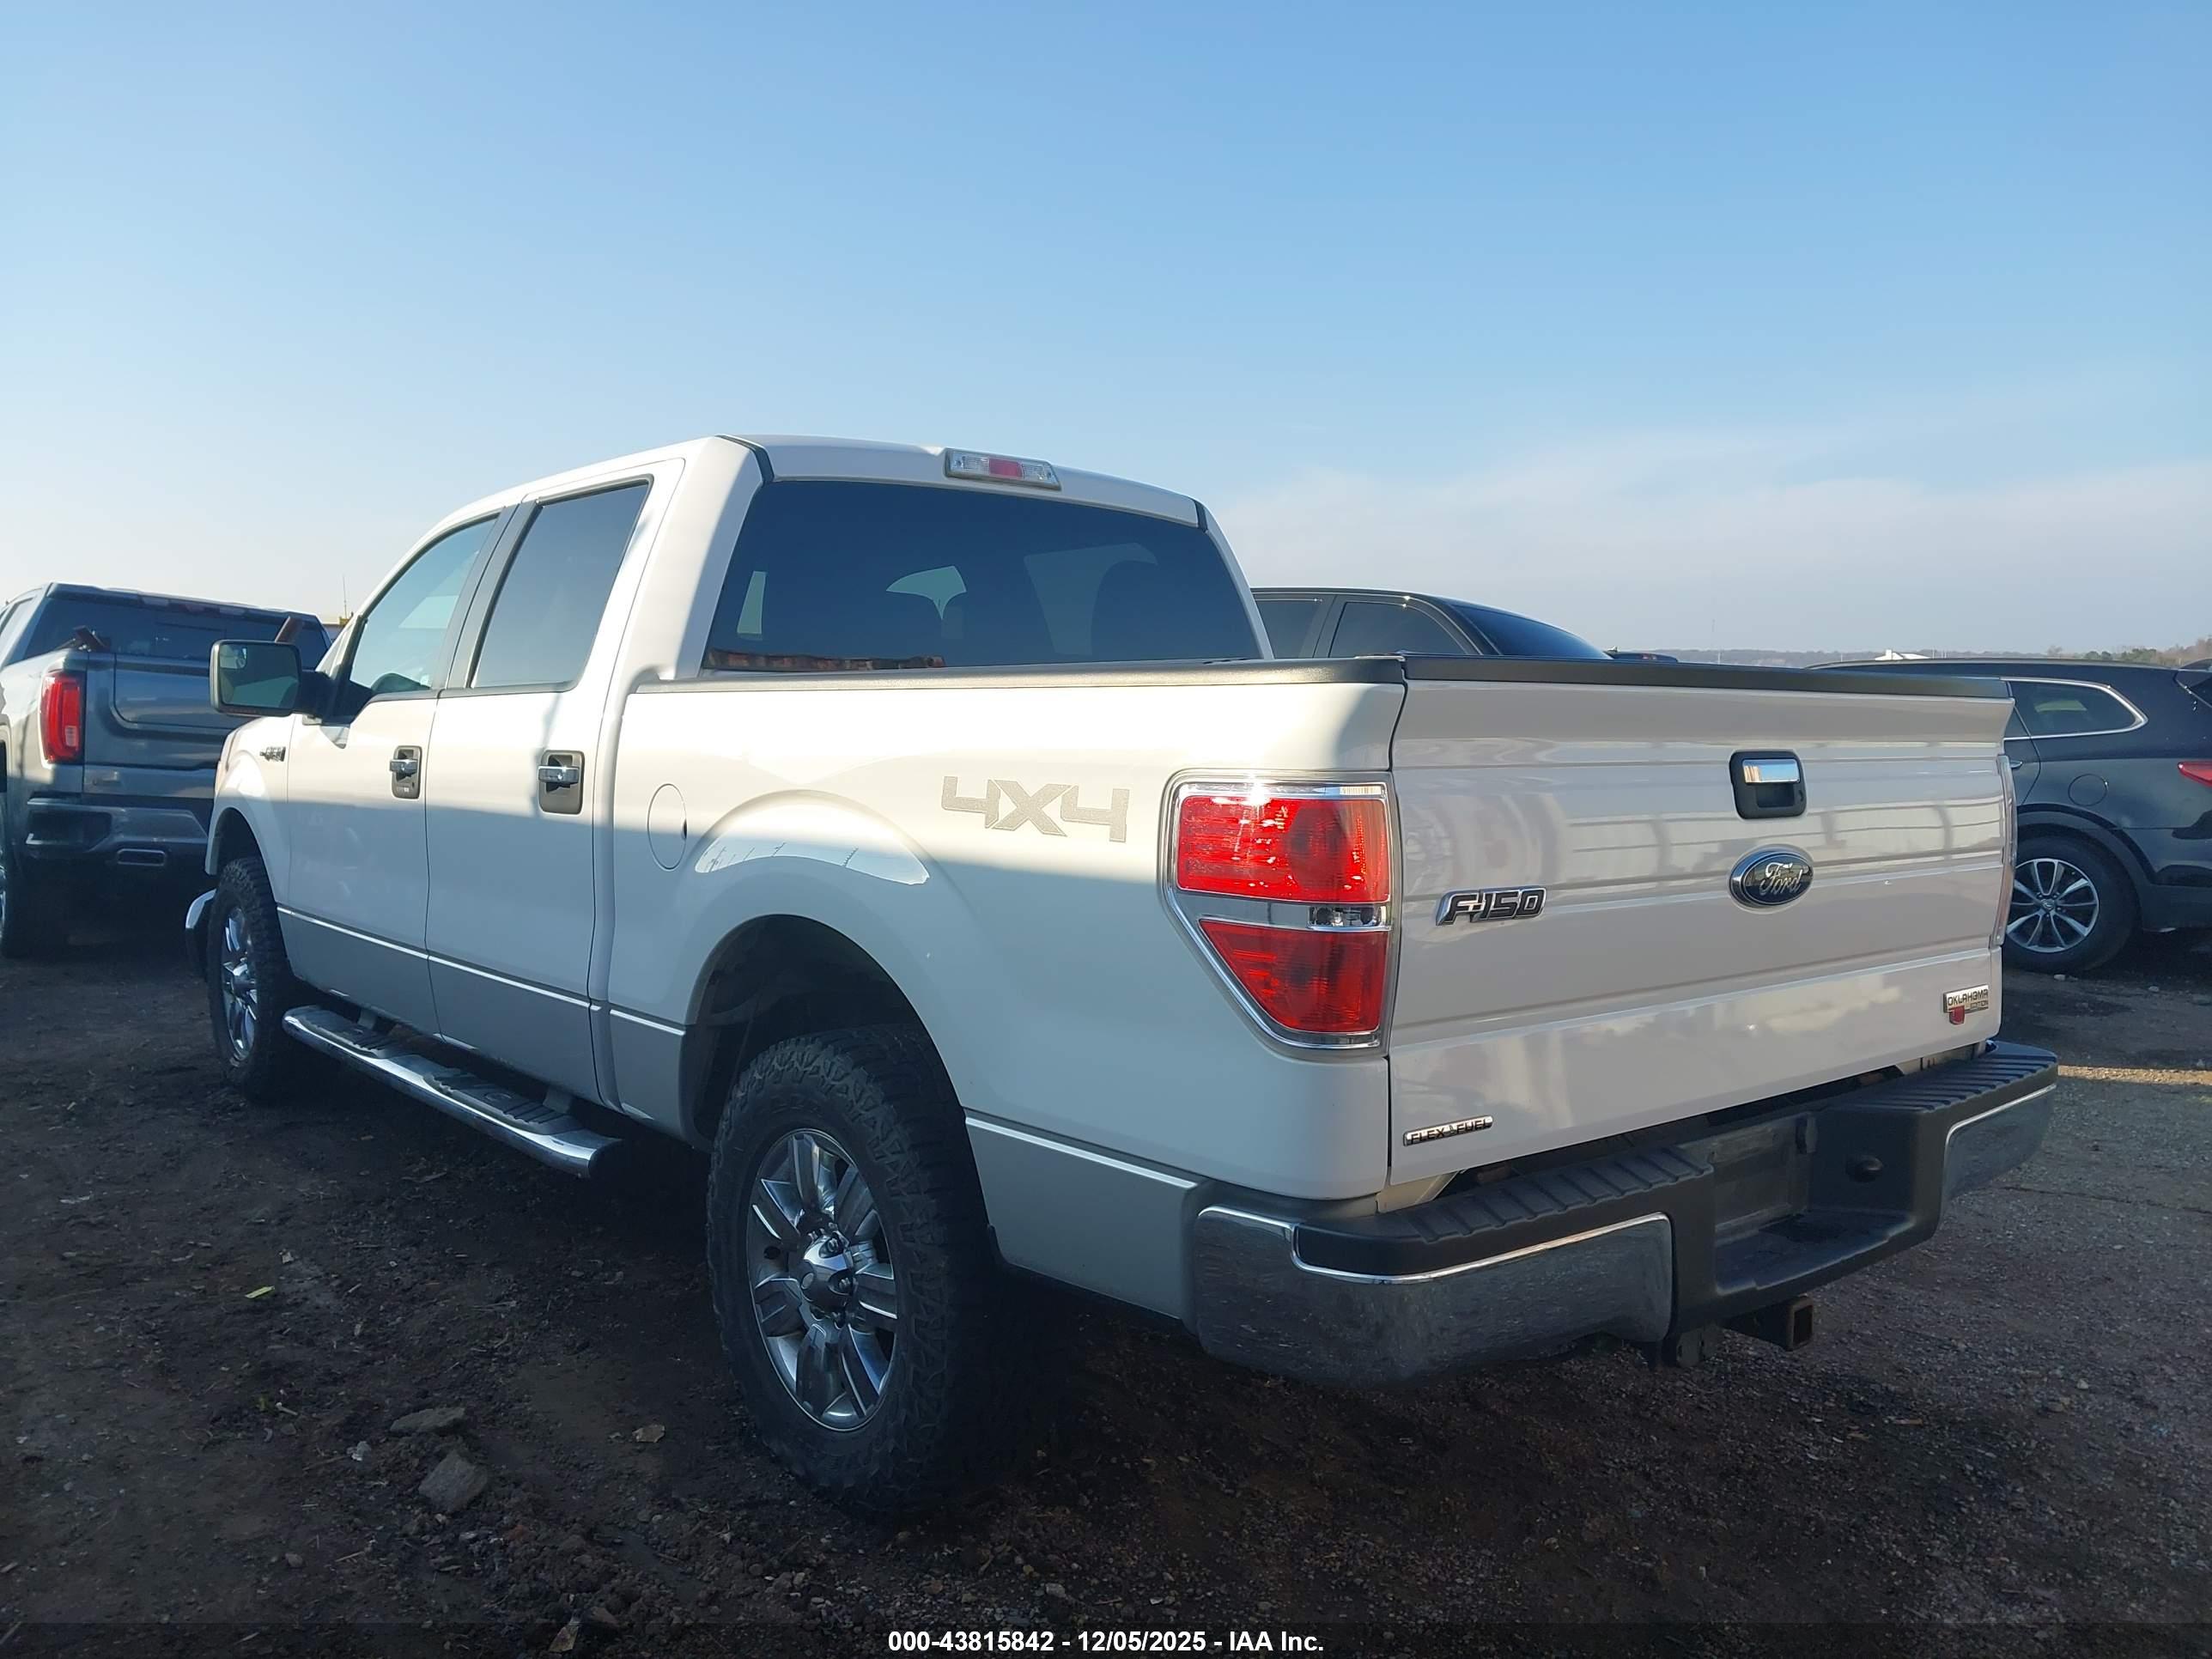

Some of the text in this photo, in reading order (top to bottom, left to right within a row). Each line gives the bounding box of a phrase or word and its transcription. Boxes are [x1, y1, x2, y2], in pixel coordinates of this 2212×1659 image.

[941, 775, 1129, 842] 4X4
[1759, 861, 1803, 896] Ford
[1947, 988, 1989, 1006] OKLAHOMA
[1410, 1118, 1489, 1144] FLEX FUEL
